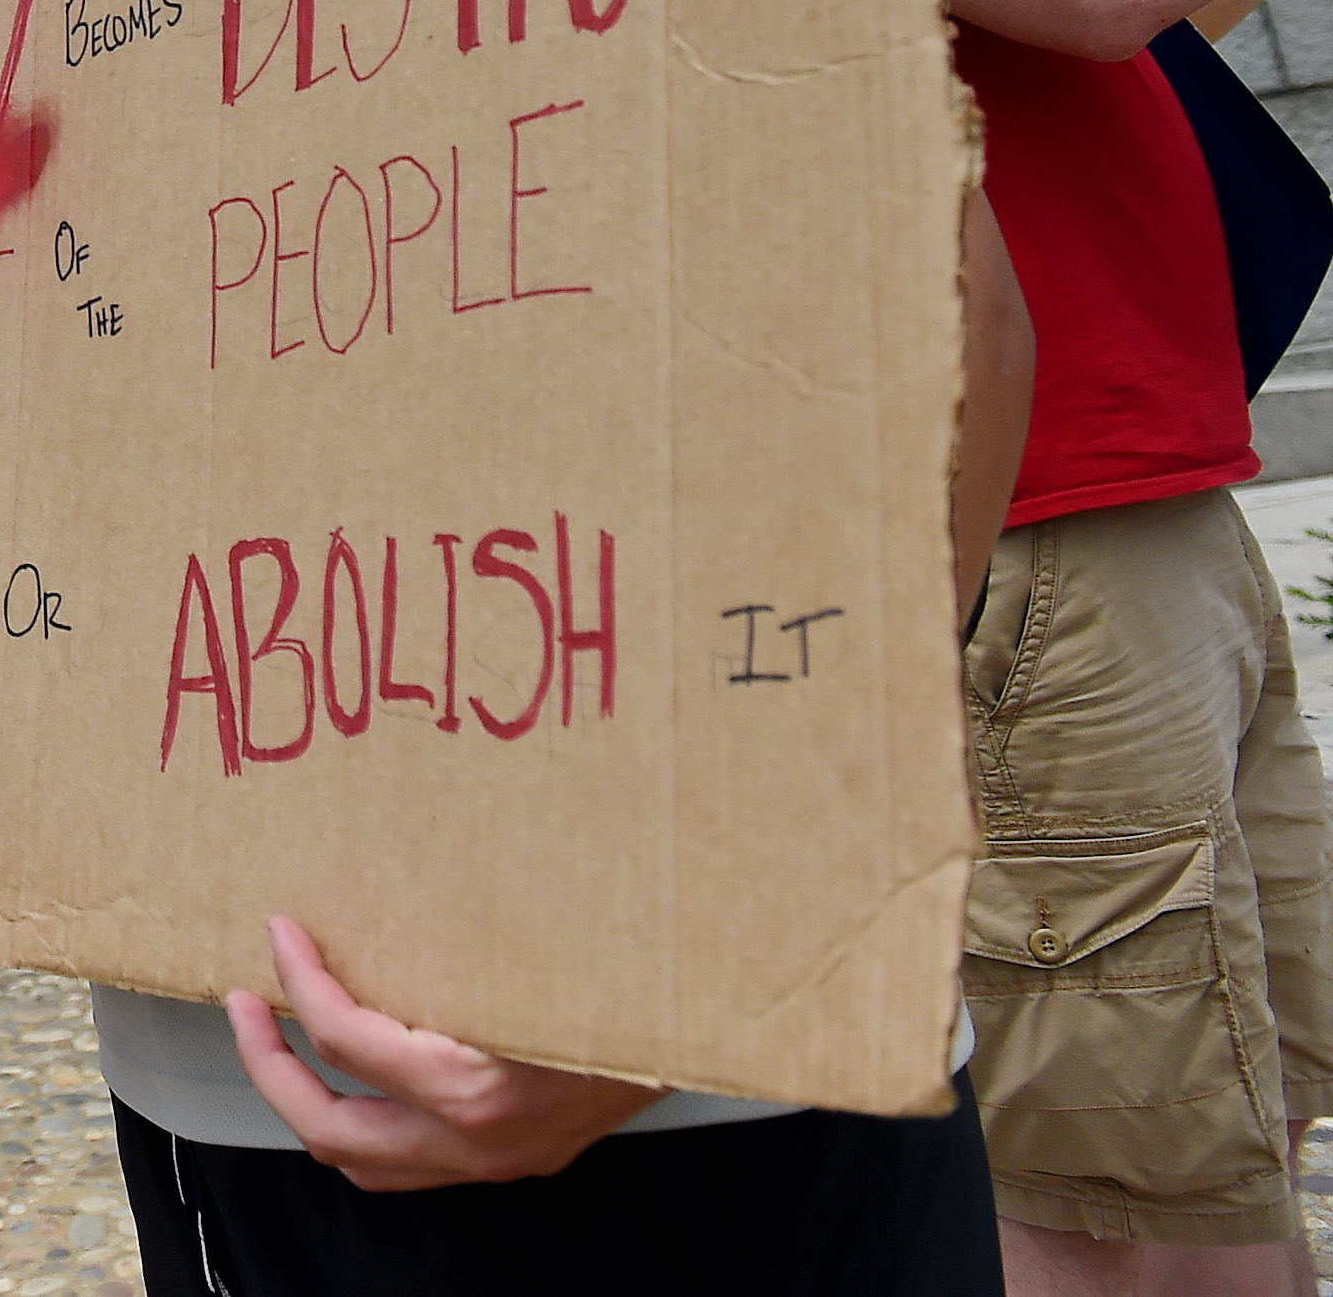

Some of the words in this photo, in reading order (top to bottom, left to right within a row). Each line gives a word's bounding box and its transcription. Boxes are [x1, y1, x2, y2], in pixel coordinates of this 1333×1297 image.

[76, 298, 125, 340] THE
[208, 100, 593, 370] PEOPLE
[159, 508, 617, 778] ABOLISH
[723, 604, 844, 686] IT
